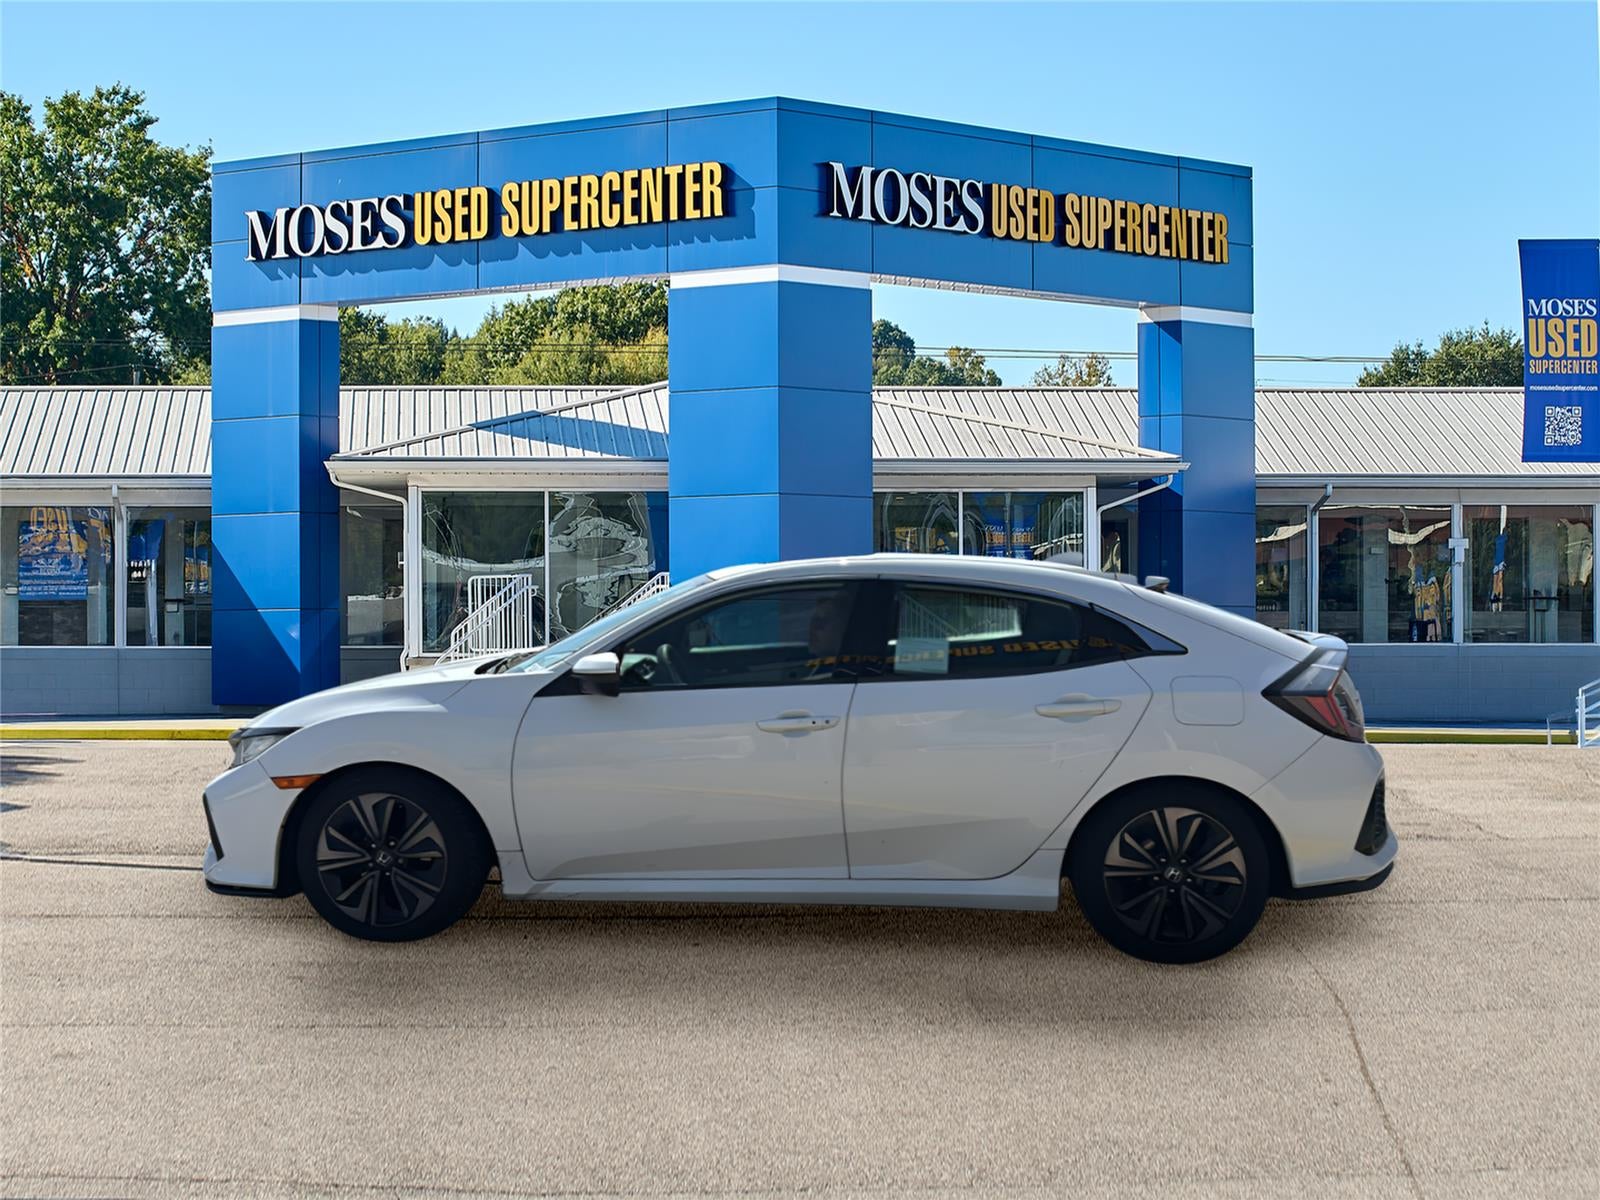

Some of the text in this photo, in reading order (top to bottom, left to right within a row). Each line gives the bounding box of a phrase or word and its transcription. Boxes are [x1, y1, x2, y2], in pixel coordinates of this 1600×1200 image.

[244, 161, 724, 262] MOSES USED SUPERCENTER
[828, 161, 1230, 264] MOSES USED SUPERCENTER
[1527, 298, 1598, 317] MOSES
[1528, 317, 1599, 358] USED
[1529, 359, 1599, 375] SUPERCENTER
